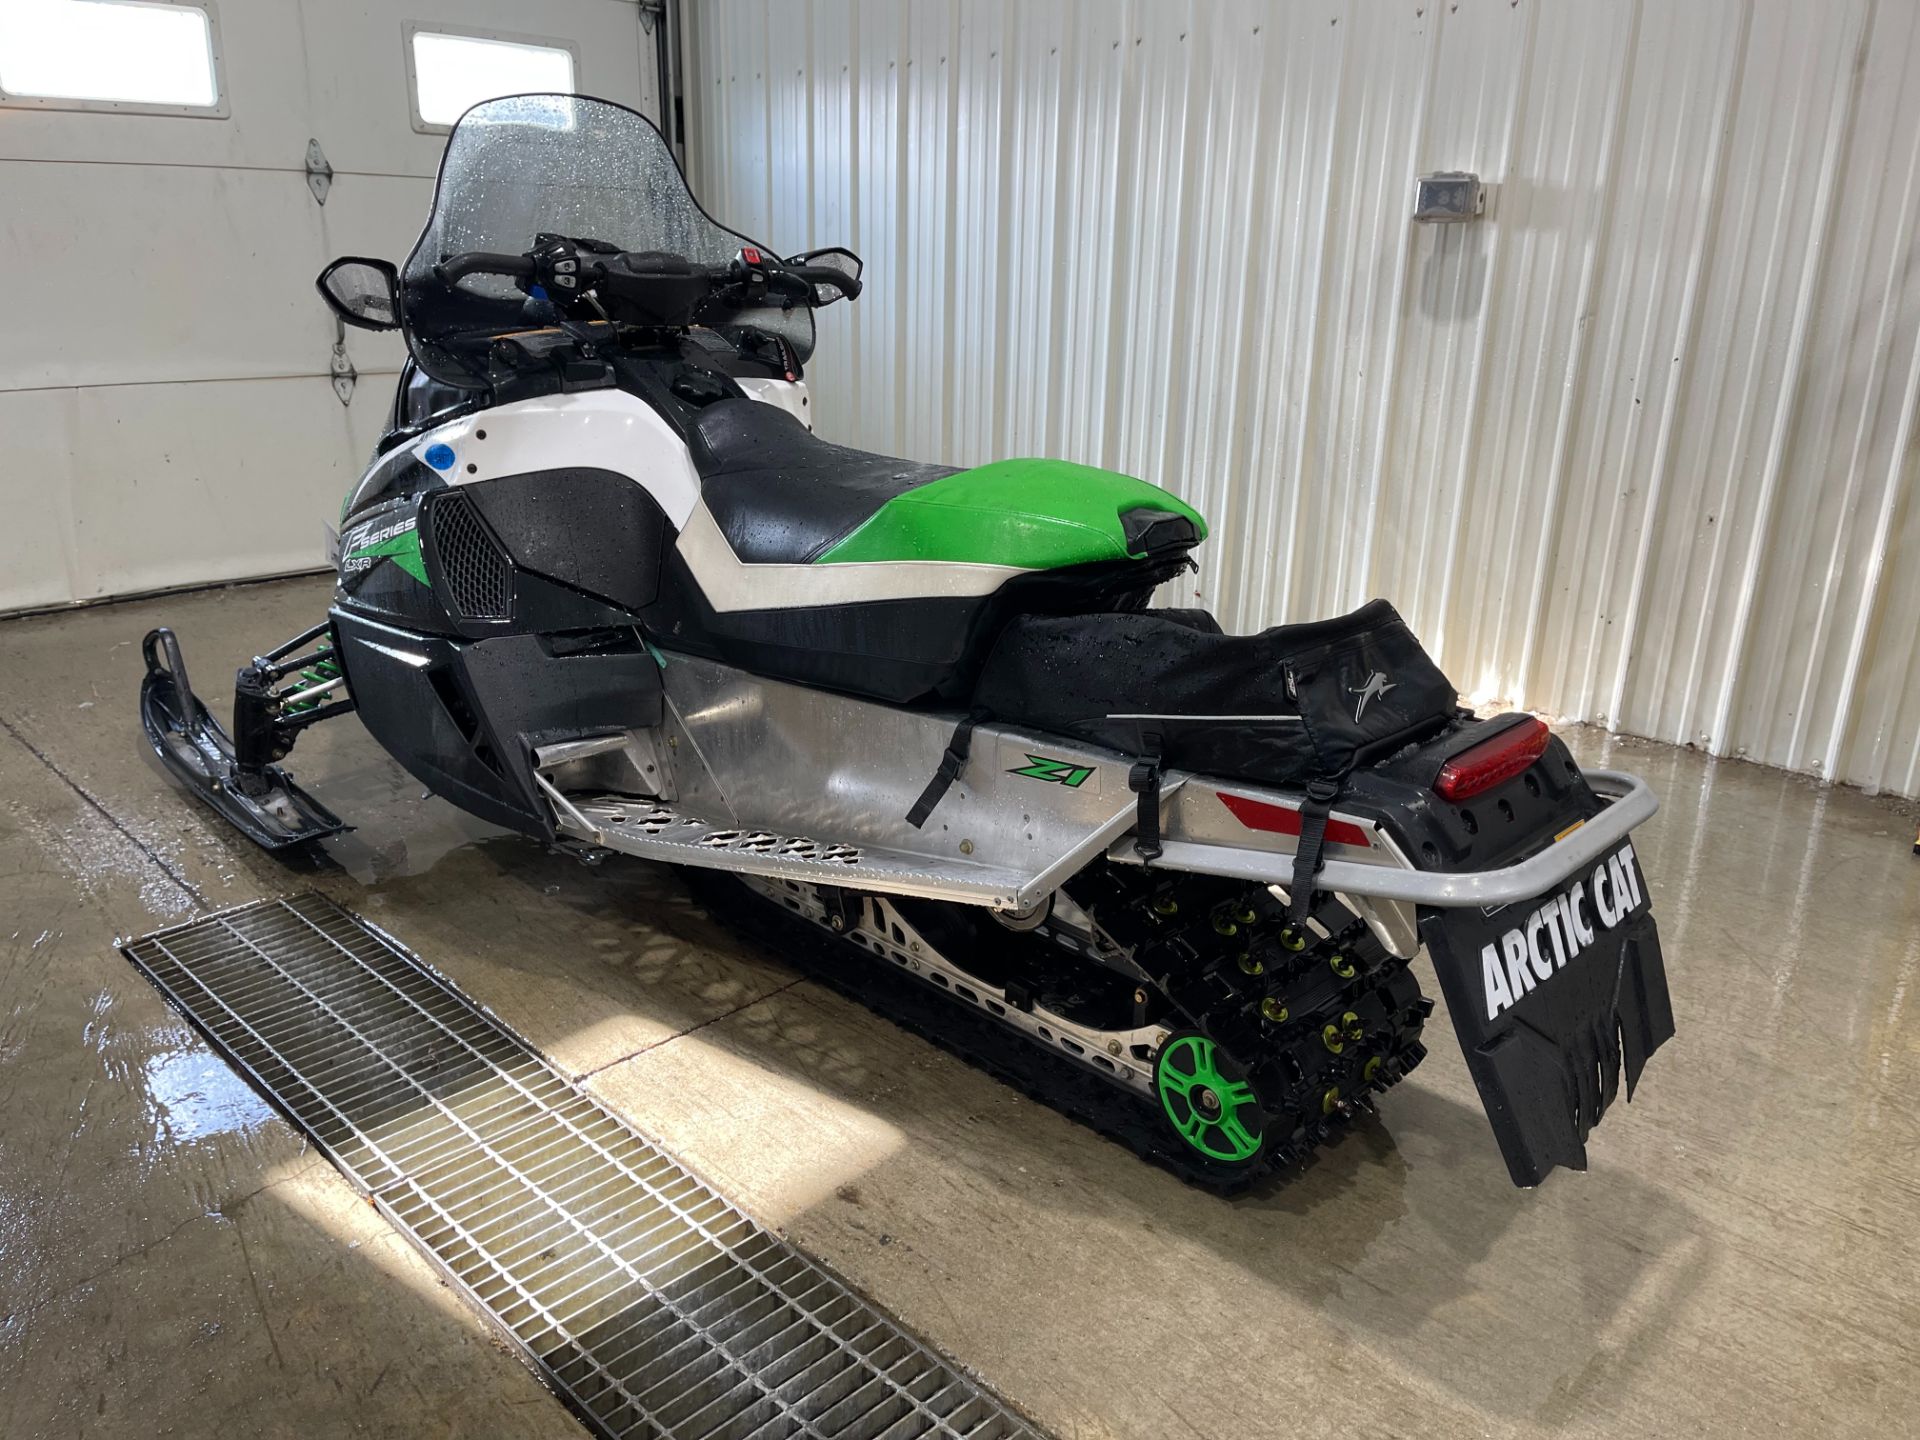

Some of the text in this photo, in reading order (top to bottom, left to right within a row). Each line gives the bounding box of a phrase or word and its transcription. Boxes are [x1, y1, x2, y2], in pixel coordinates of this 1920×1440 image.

[360, 517, 417, 549] SERIES
[344, 557, 371, 572] LXR
[1005, 753, 1097, 788] Z1
[1481, 844, 1642, 1021] ARCTIC CAT
